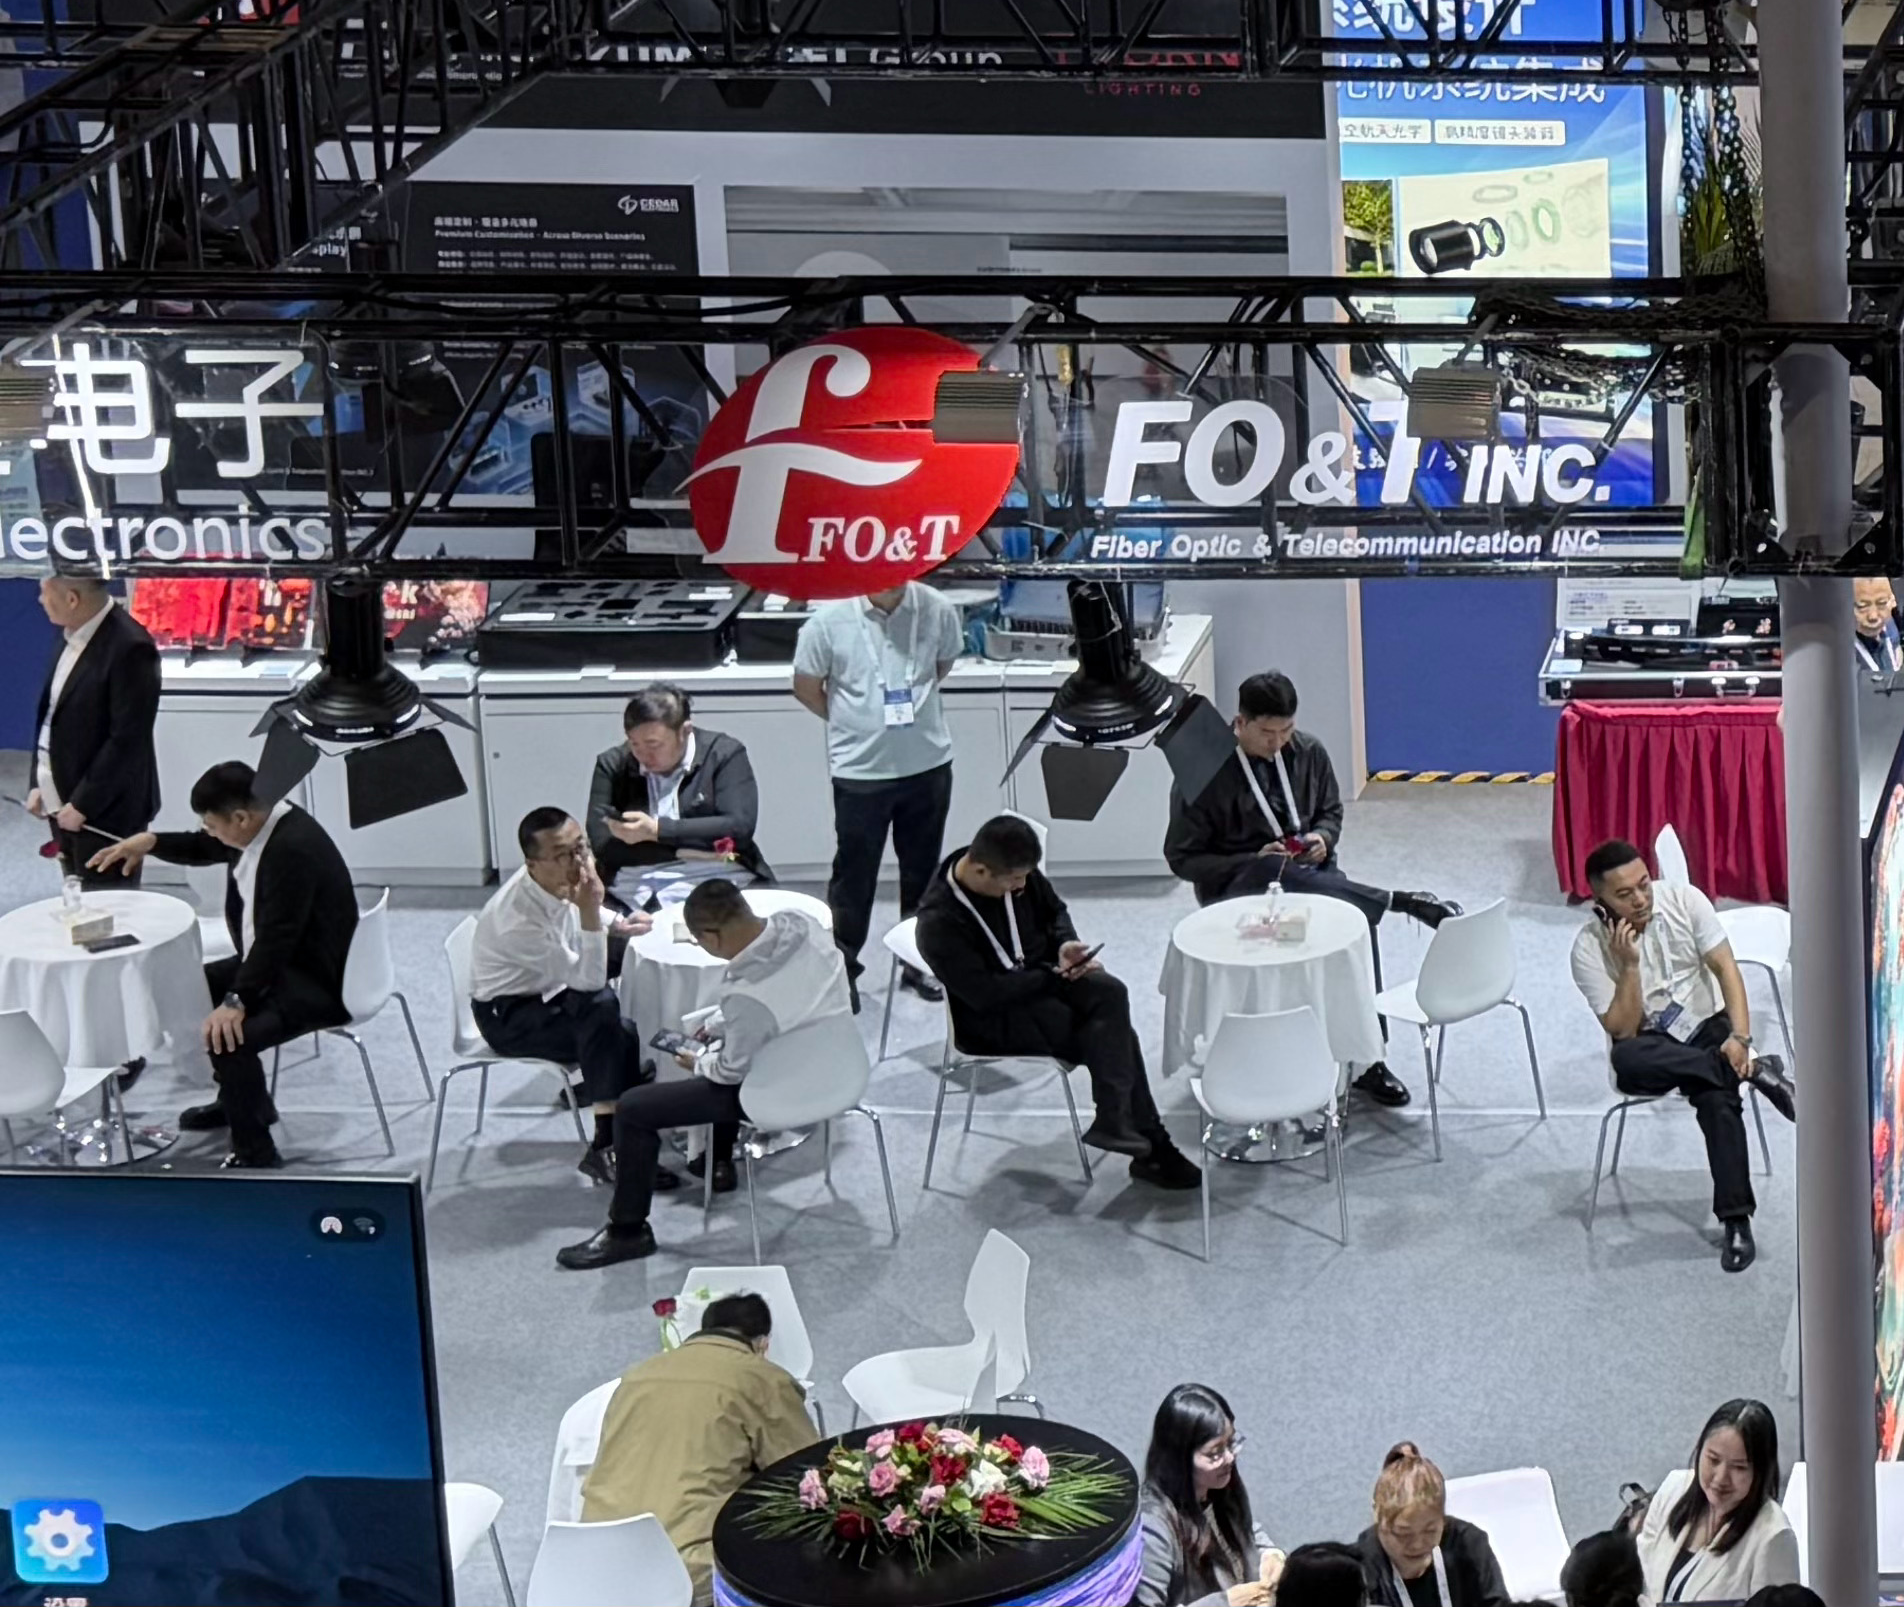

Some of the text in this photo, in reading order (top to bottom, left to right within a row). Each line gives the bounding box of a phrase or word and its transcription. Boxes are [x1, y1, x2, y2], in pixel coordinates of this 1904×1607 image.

[1083, 83, 1200, 97] LIGHTING
[1105, 399, 1611, 508] FO&T INC.
[806, 514, 960, 565] FO&T
[1091, 529, 1611, 561] Fiber Optic & Telecommunication INC.
